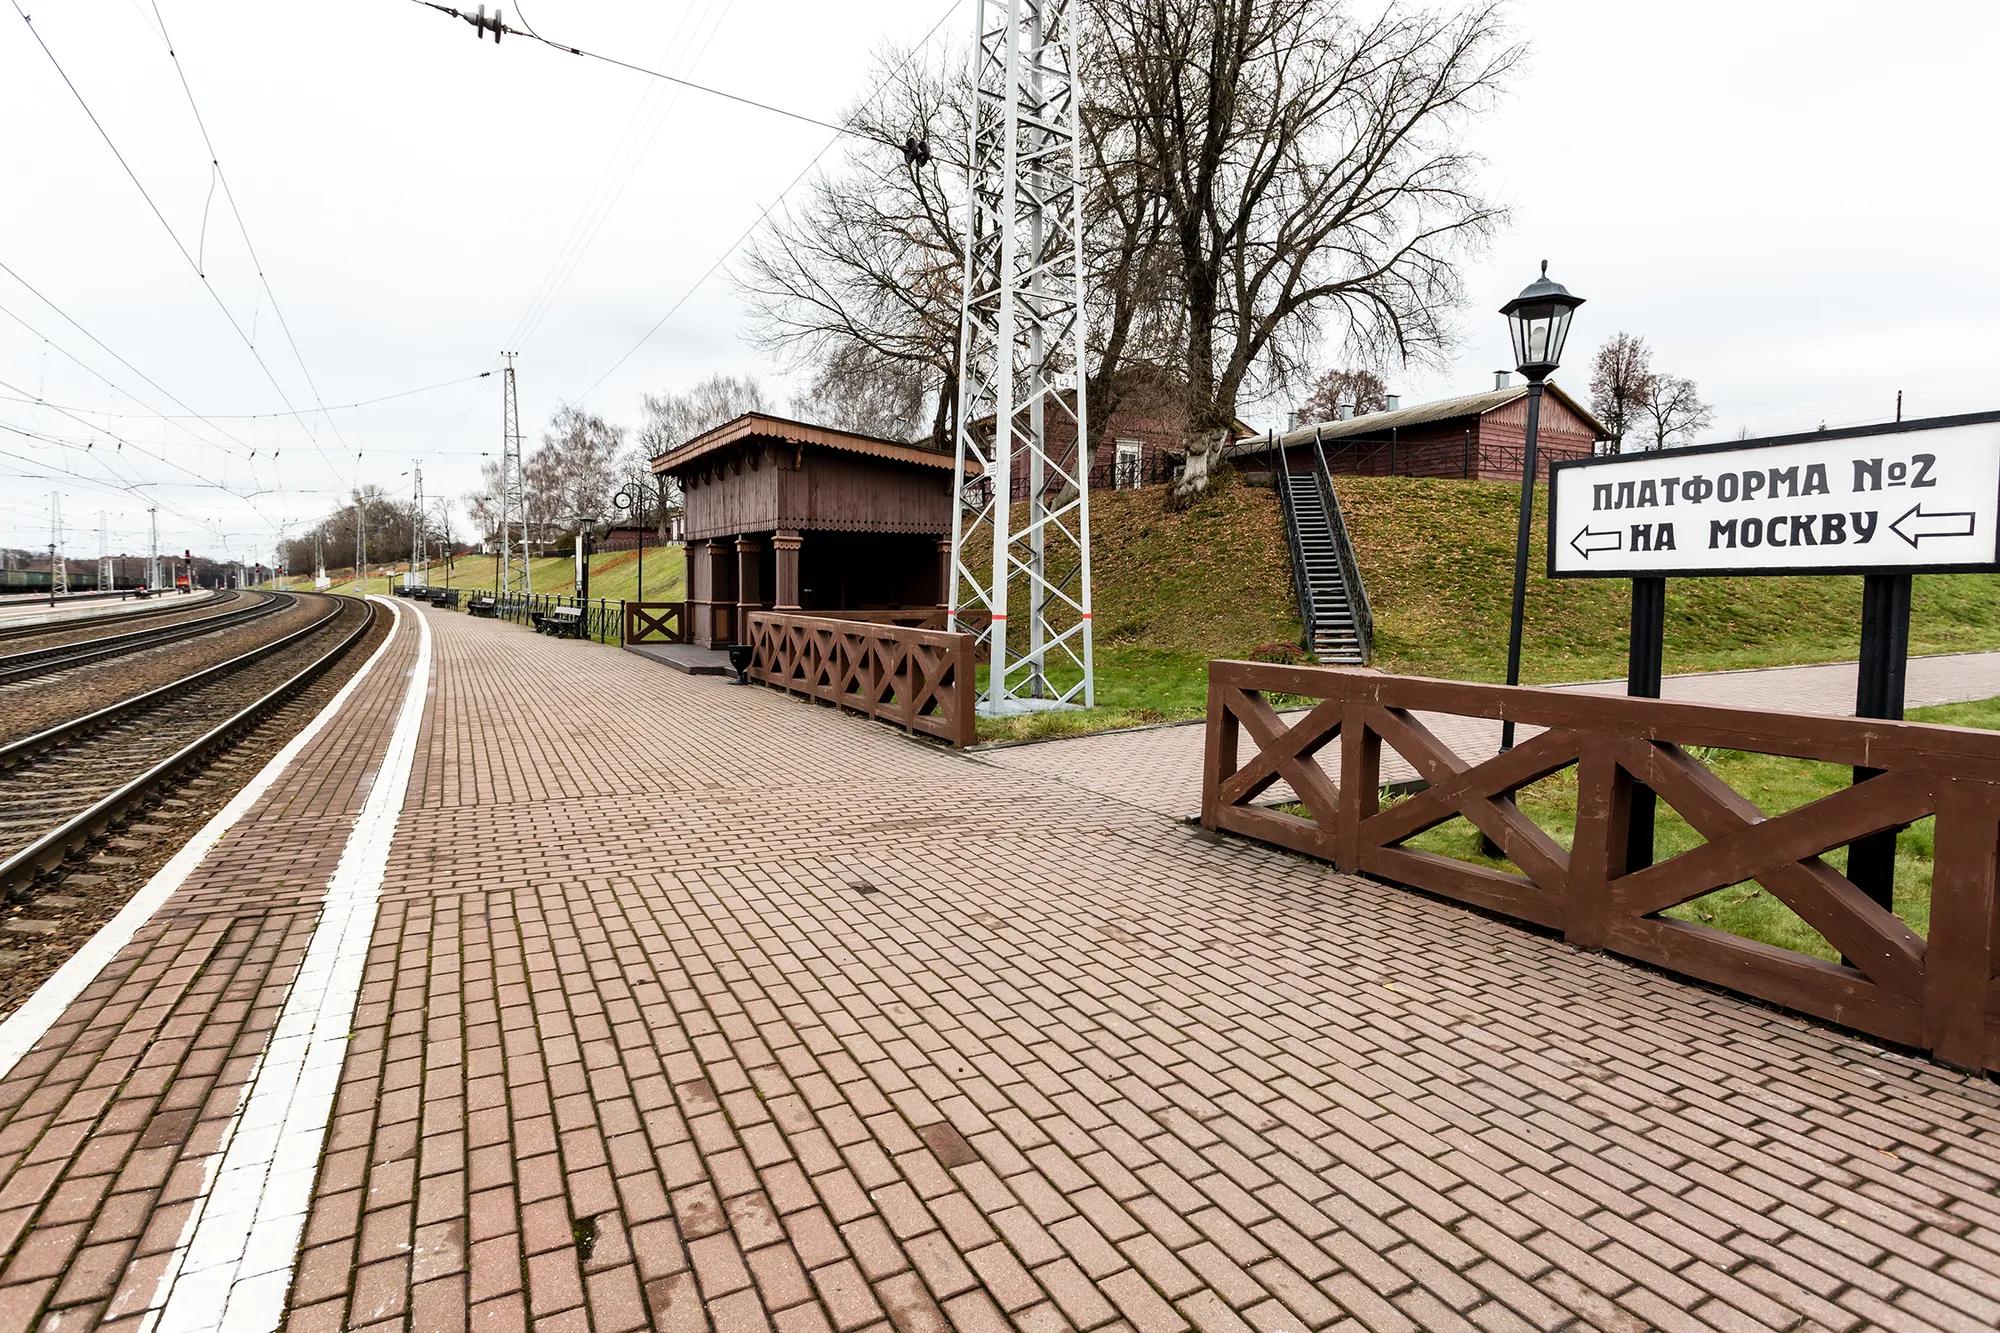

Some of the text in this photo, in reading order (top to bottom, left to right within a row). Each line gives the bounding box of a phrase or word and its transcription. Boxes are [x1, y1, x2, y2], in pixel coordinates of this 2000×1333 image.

[1593, 463, 1830, 511] ПЛАТФОРМА
[1629, 511, 1878, 552] НА МОСКВУ
